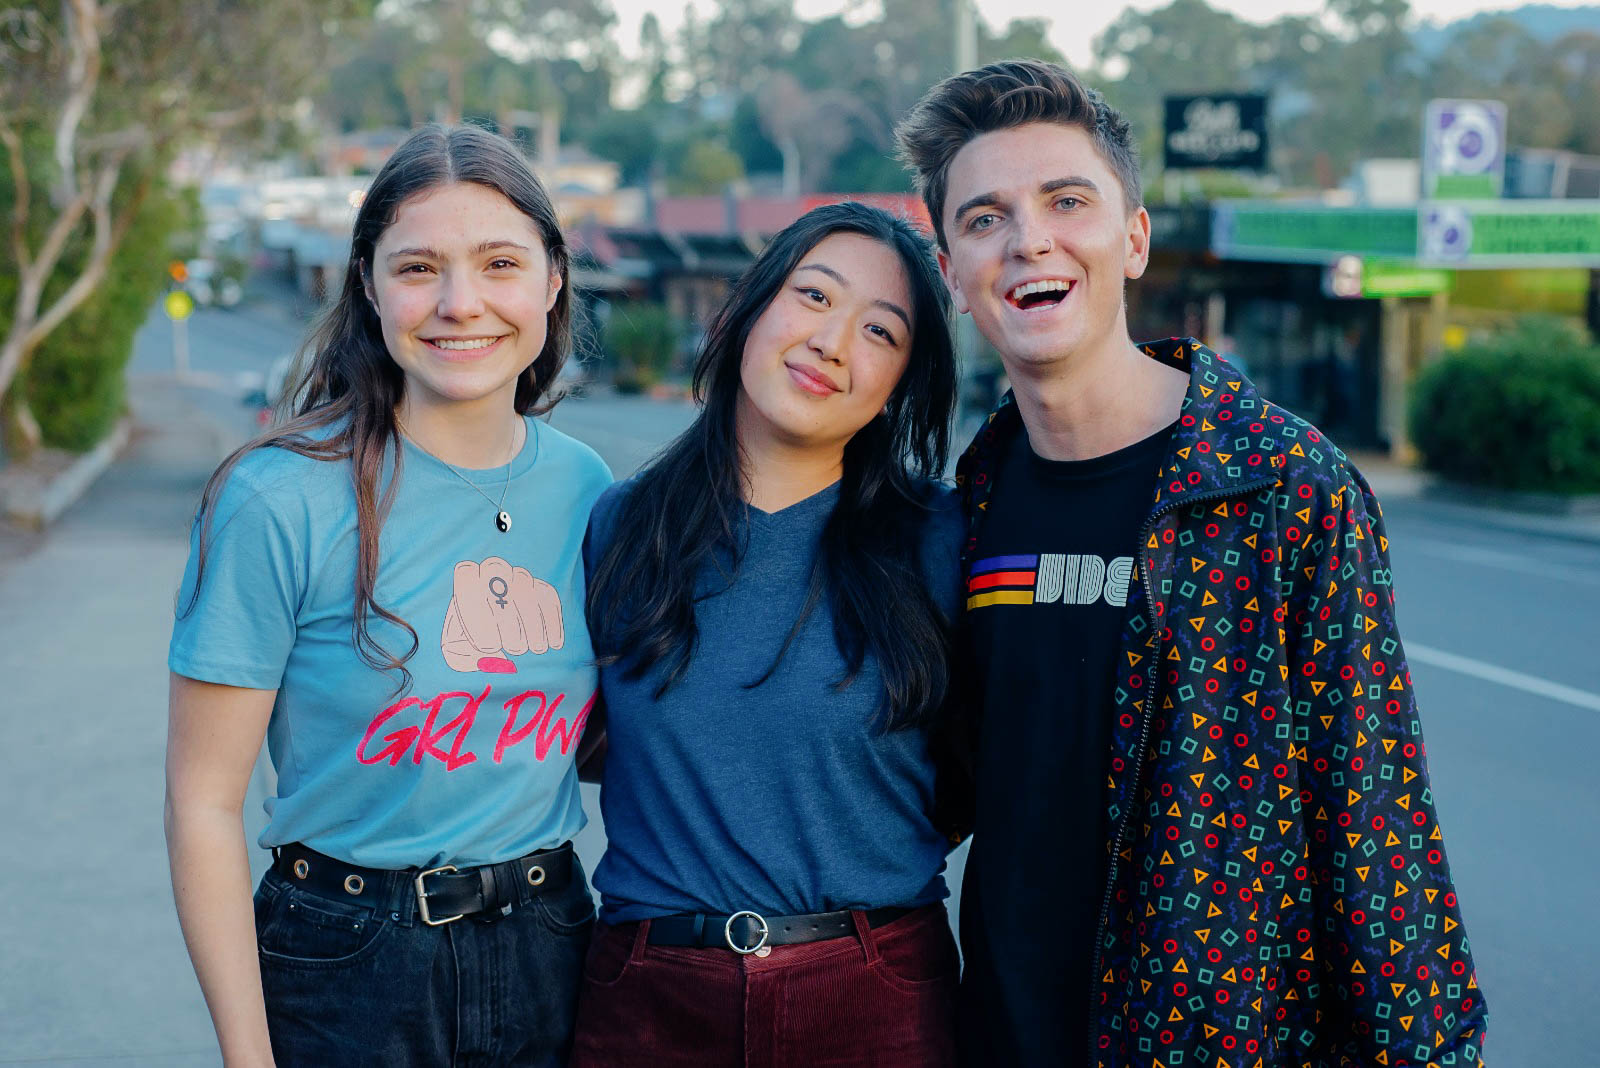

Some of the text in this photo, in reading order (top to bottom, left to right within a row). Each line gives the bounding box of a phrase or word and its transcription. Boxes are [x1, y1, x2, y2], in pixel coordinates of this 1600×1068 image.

[1036, 553, 1135, 607] VIDE
[356, 684, 599, 771] GRL PW
